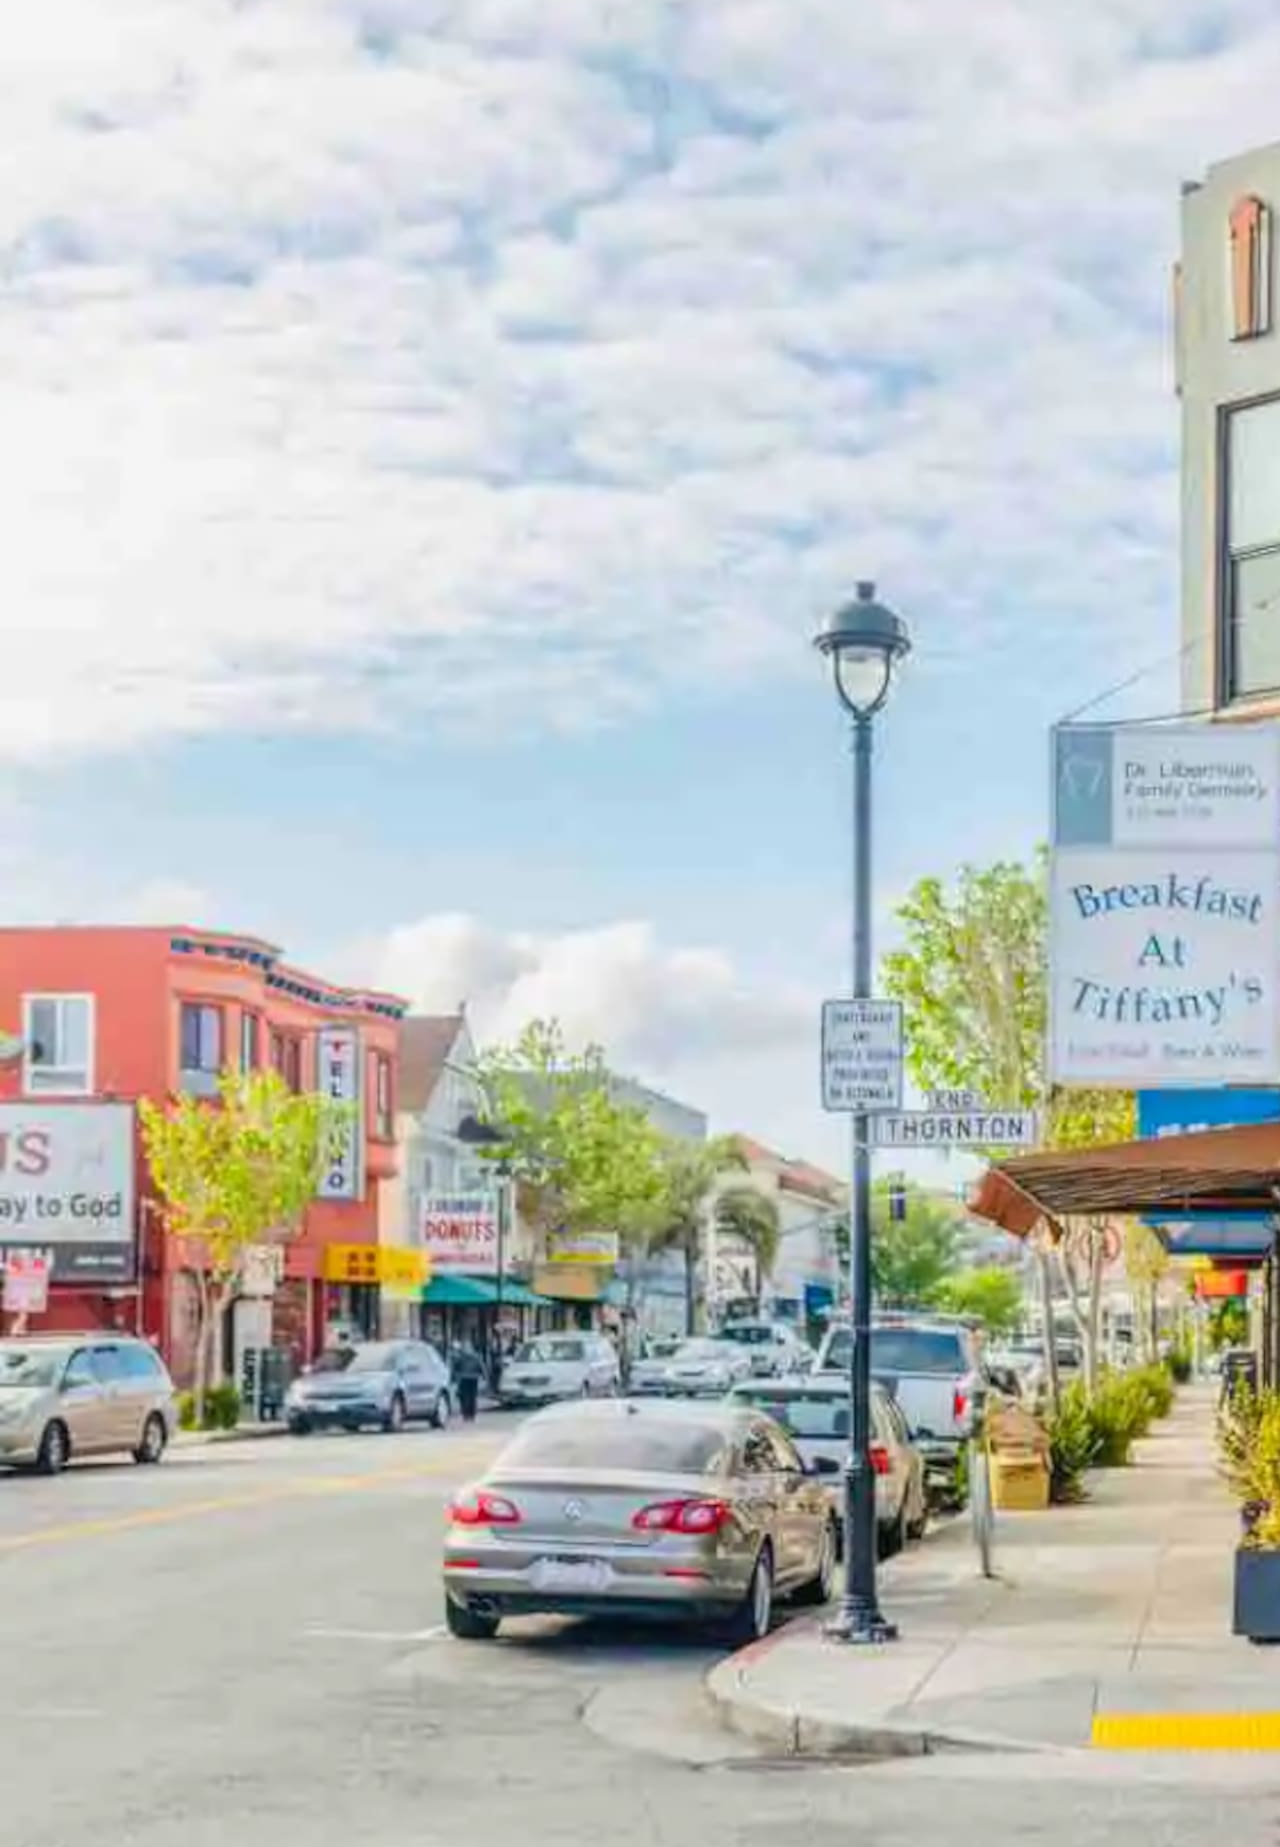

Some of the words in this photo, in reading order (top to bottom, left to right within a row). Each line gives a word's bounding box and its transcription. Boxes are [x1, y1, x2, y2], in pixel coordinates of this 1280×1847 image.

[1070, 874, 1263, 923] Breakfast
[1138, 931, 1184, 967] At
[1072, 971, 1264, 1026] Tiffany's
[887, 1117, 1023, 1141] THORNTON
[36, 1195, 61, 1218] to
[70, 1193, 121, 1218] God
[425, 1219, 496, 1242] DONUTS
